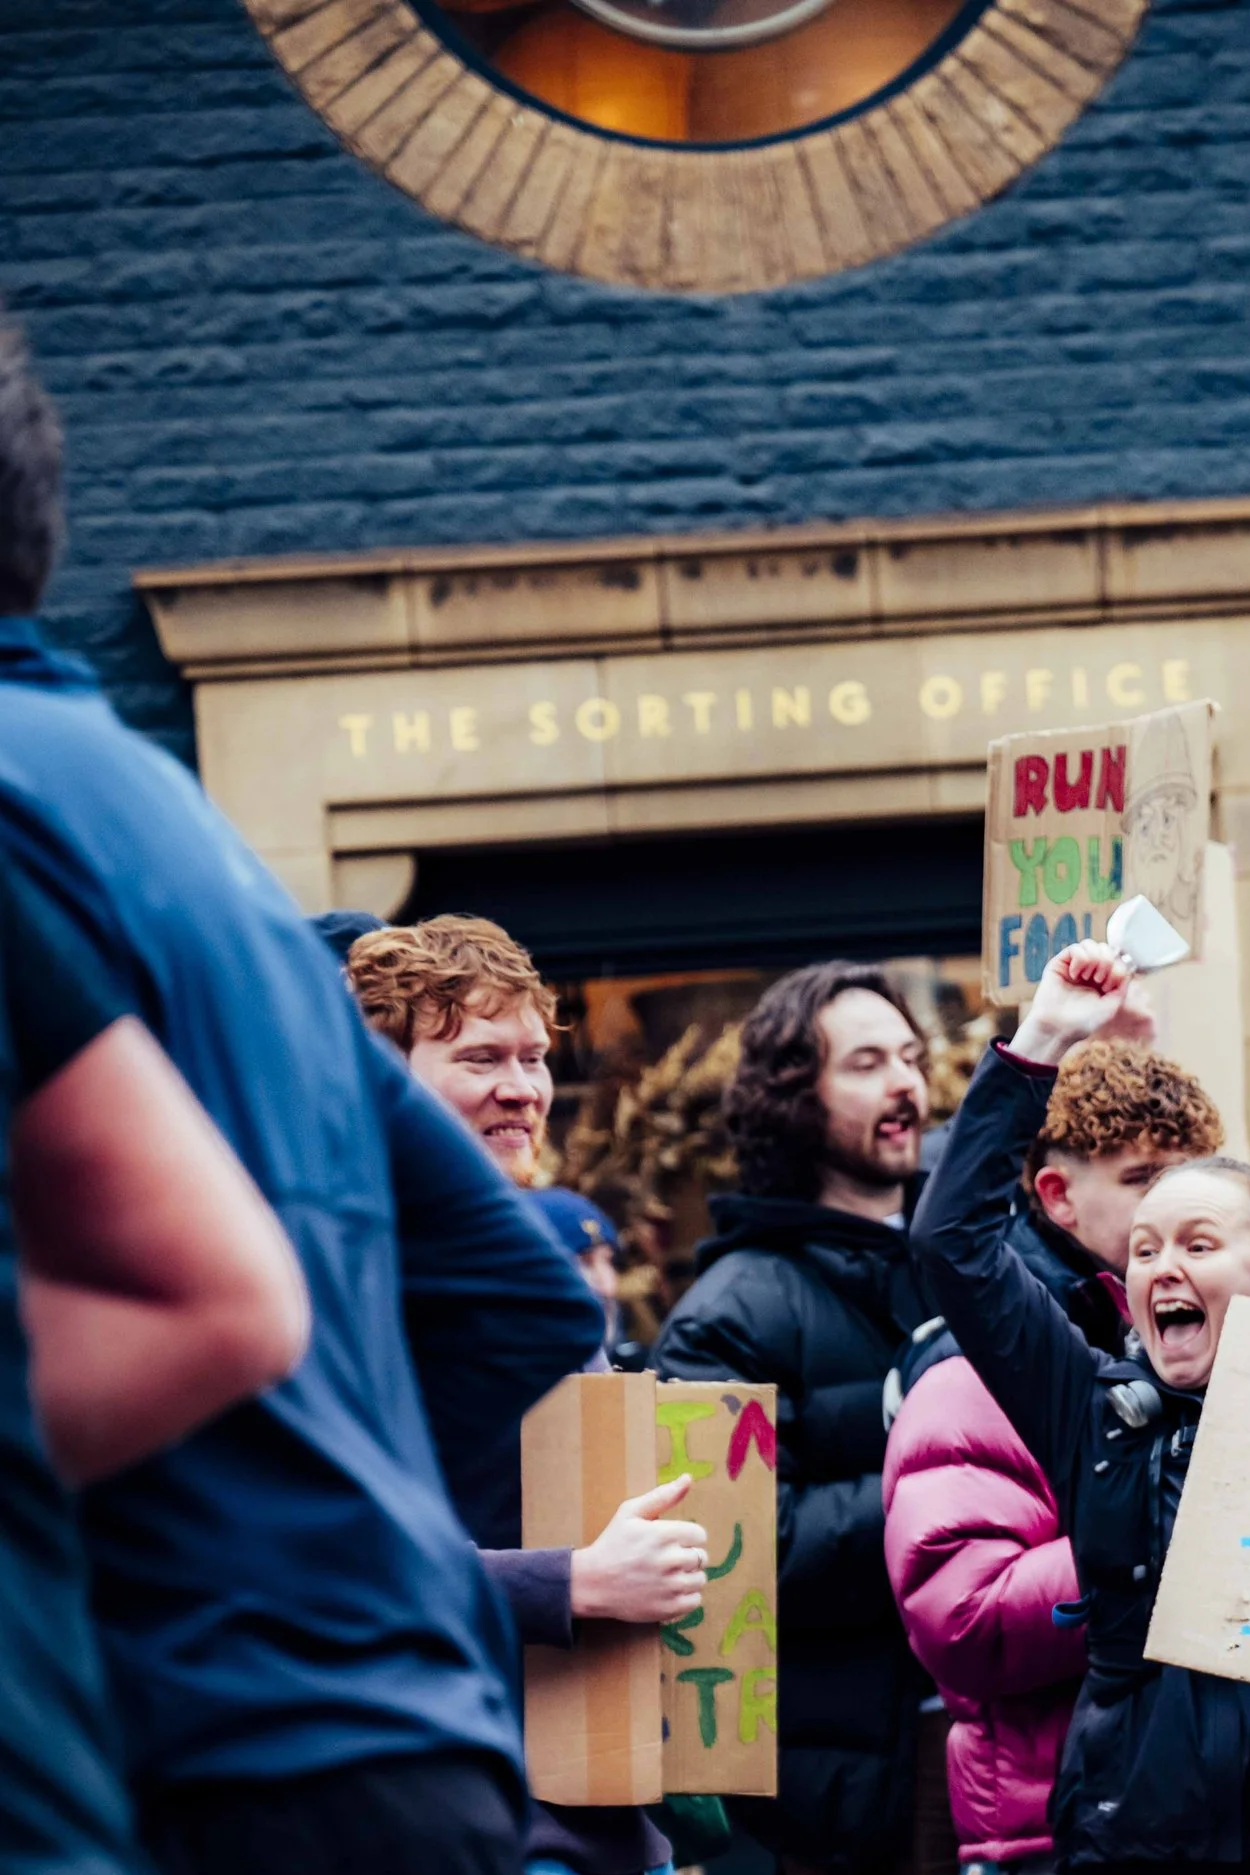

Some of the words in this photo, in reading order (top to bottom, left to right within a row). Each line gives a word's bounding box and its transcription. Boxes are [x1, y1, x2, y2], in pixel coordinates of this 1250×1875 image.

[339, 707, 480, 757] THE
[528, 680, 871, 746] SORTING
[919, 659, 1193, 719] OFFICE
[1013, 745, 1127, 818] RUN
[1009, 835, 1123, 908] YOU
